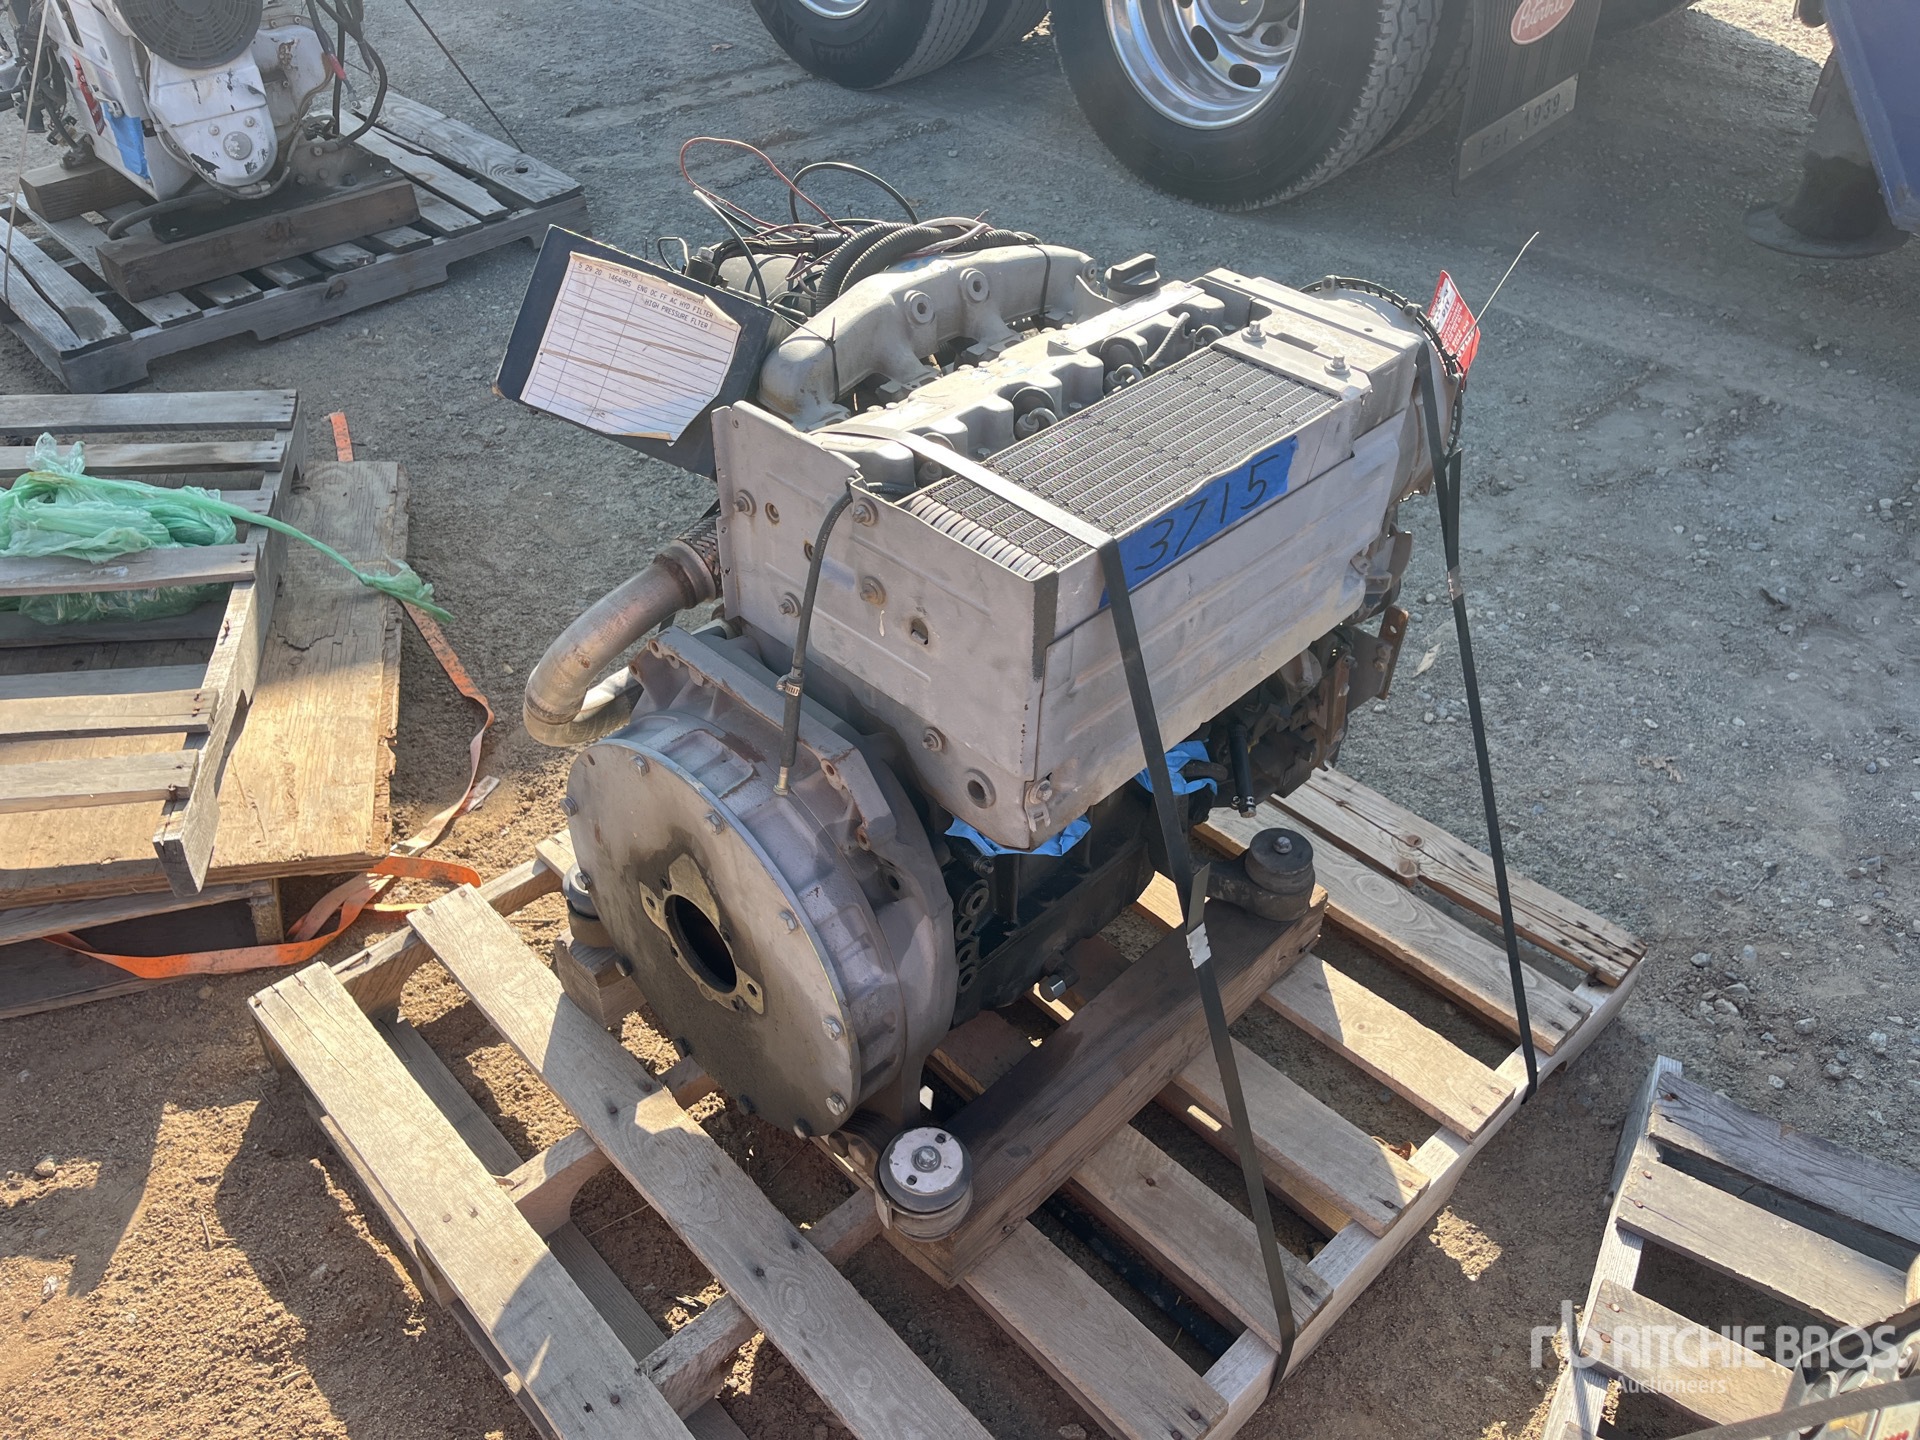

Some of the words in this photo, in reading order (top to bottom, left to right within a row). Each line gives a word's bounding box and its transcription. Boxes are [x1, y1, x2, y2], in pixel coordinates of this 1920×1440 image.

[1523, 92, 1561, 131] 1939
[585, 264, 592, 272] 29
[637, 285, 648, 294] ENG
[660, 291, 668, 300] FF
[669, 296, 677, 305] AC
[679, 300, 690, 310] HYD
[693, 305, 714, 319] FILTER
[644, 299, 659, 309] HIGH
[661, 304, 688, 321] PRESSURE
[1134, 454, 1279, 571] 3715
